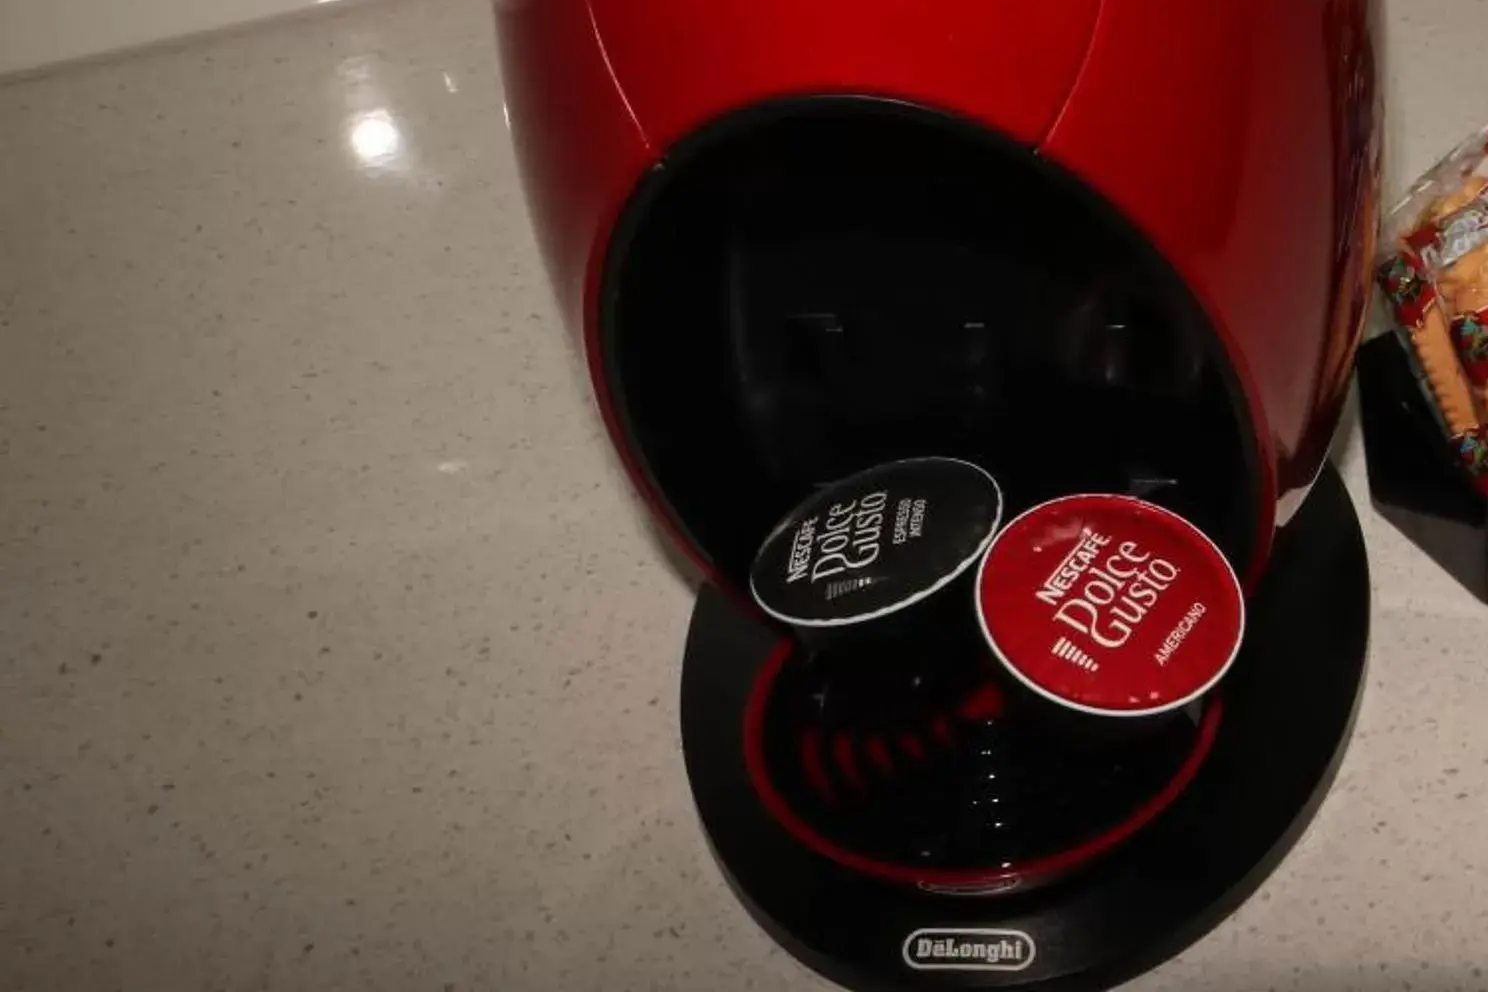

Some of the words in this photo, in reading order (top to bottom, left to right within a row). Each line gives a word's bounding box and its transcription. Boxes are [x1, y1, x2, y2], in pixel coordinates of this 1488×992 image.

[811, 500, 857, 583] Dolce
[846, 490, 889, 568] Gusto
[1052, 541, 1151, 635] Dolce
[1091, 558, 1179, 647] Gusto
[1155, 602, 1207, 667] AMERICANO
